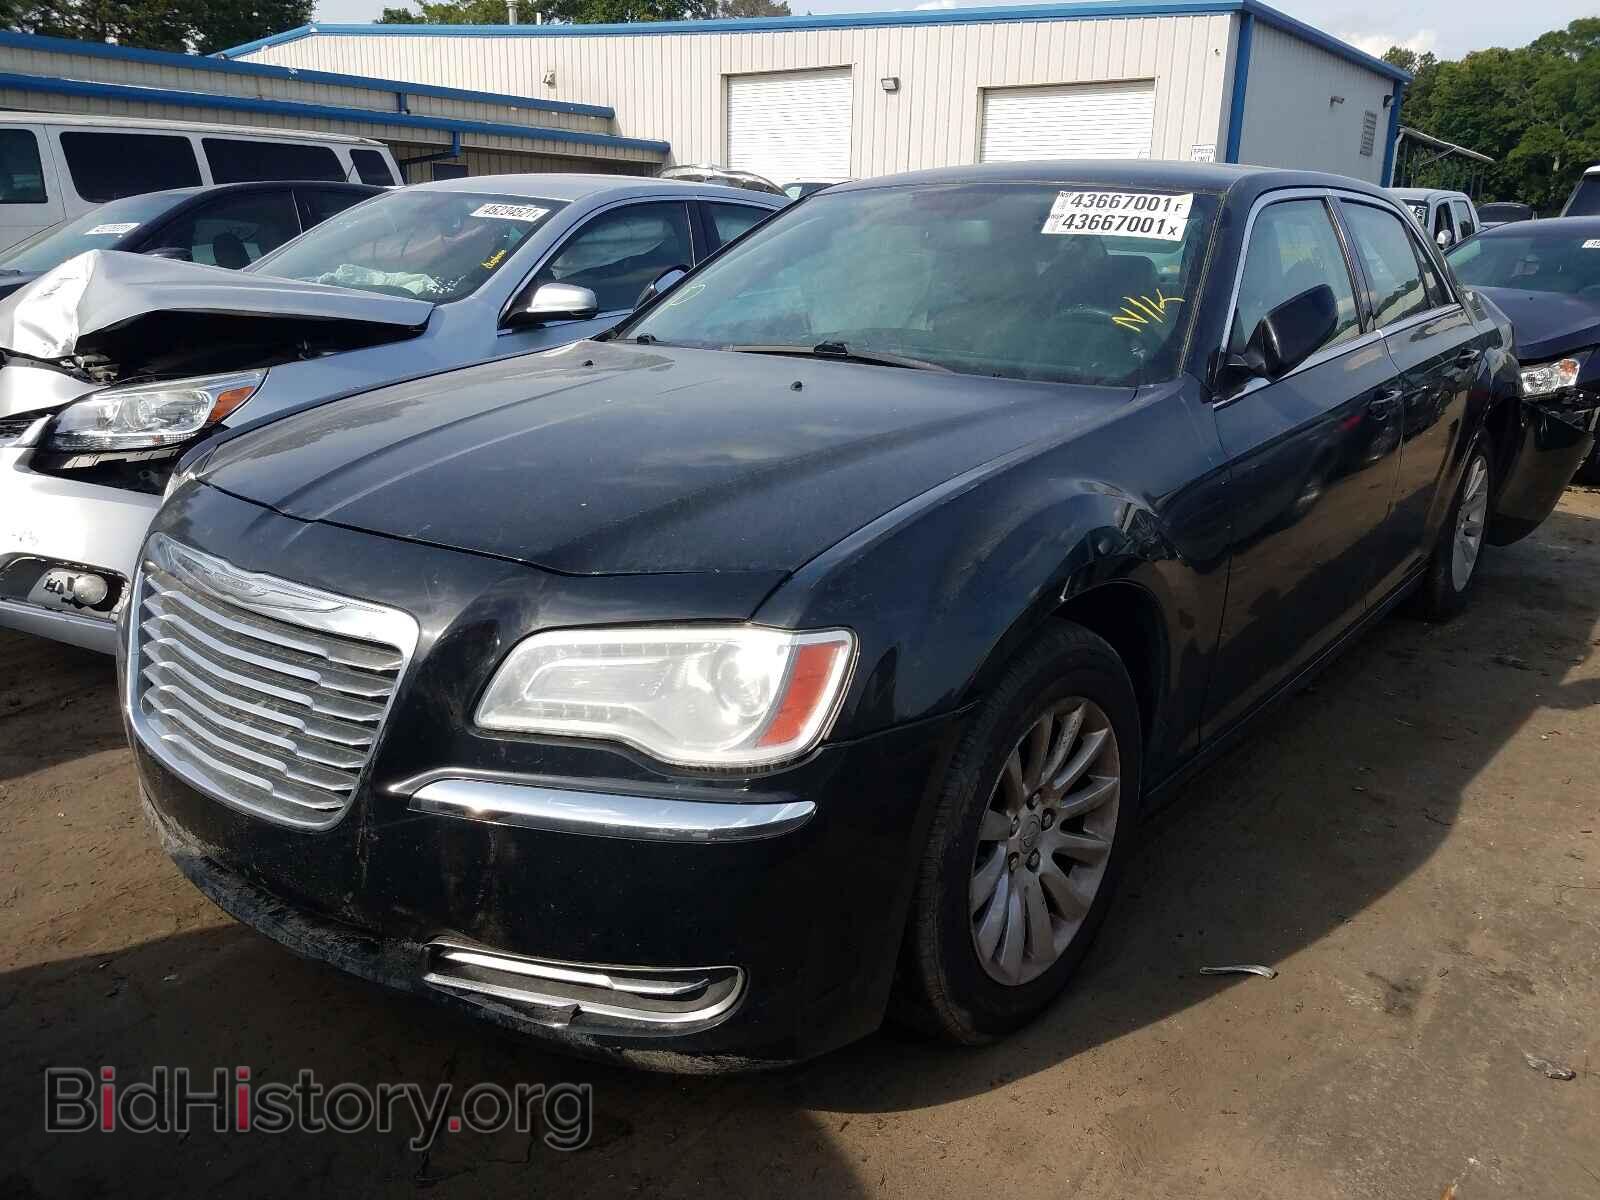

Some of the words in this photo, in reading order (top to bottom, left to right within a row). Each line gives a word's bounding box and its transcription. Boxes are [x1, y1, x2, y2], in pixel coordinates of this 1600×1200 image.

[1070, 193, 1172, 212] 43667001
[1174, 203, 1183, 212] F
[1062, 213, 1166, 235] 43667001
